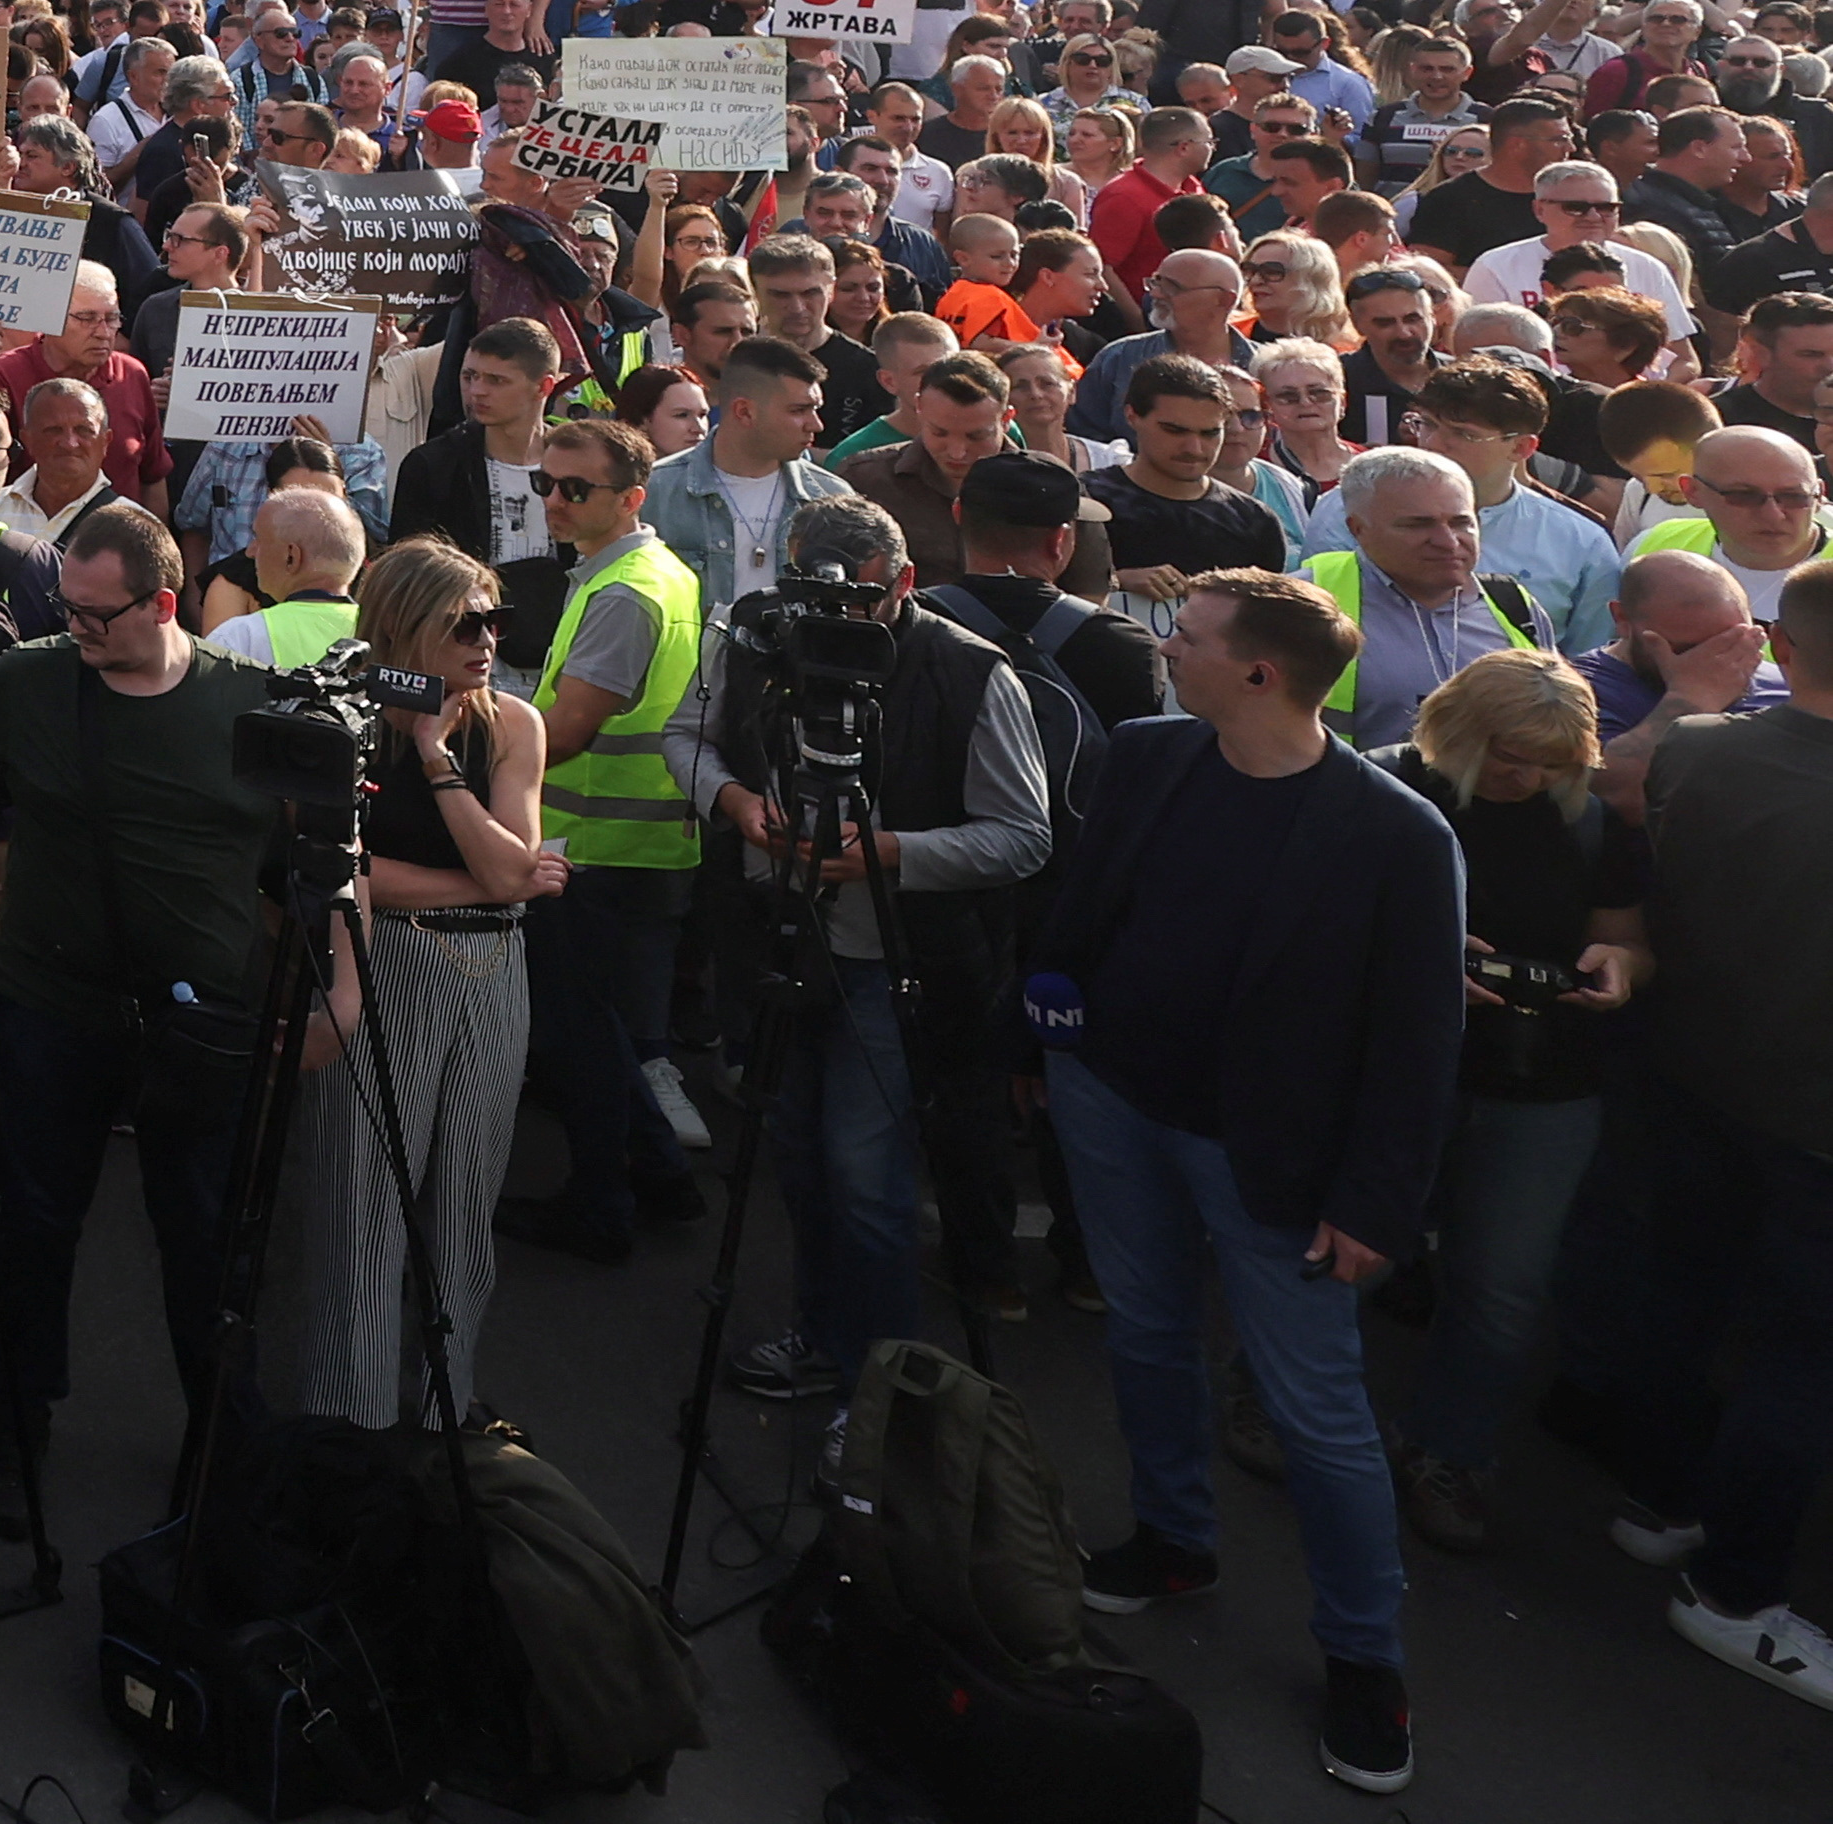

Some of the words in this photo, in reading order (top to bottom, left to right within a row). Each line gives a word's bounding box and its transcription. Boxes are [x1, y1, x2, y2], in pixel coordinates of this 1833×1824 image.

[786, 10, 897, 37] ЖРТАВА
[532, 102, 668, 146] УСТАЛА
[559, 136, 649, 165] ЦЕЛА
[517, 143, 636, 187] СРБИЈА
[13, 247, 73, 275] БУДЕ
[201, 313, 349, 343] НЕПРЕКИДНА
[180, 346, 361, 375] МАНИПУЛАЦИЈА
[195, 381, 340, 405] ПОВЕЋАЊЕМ
[214, 415, 298, 437] ПЕНЗИЈ
[379, 667, 413, 687] RTV
[1047, 1008, 1084, 1028] N1
